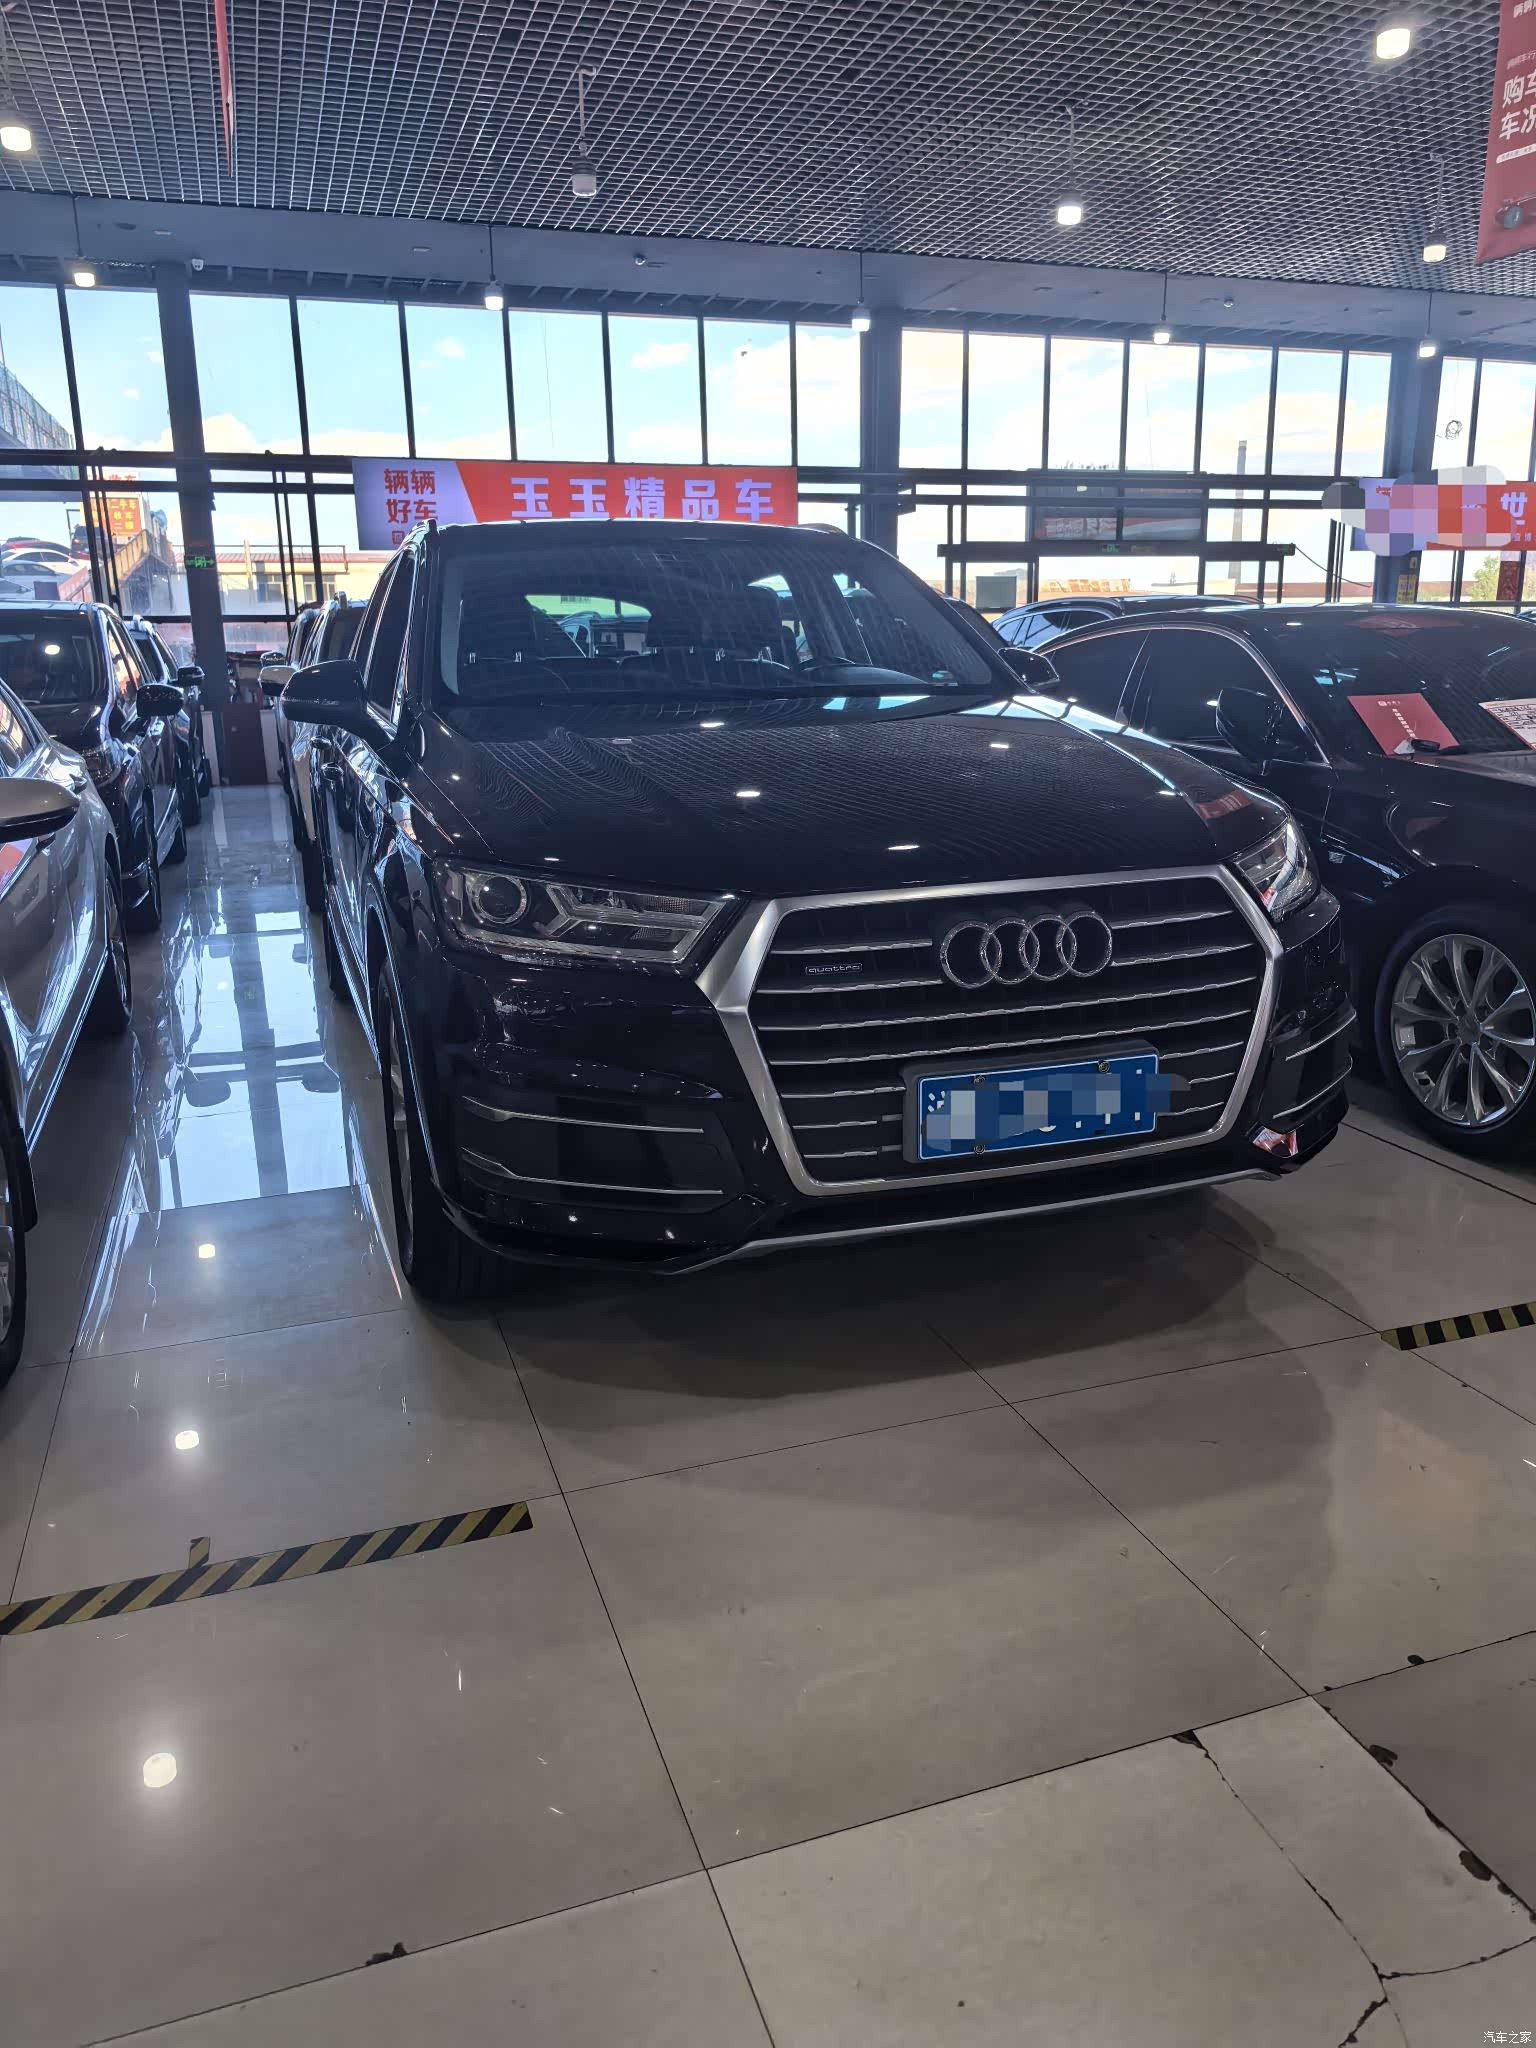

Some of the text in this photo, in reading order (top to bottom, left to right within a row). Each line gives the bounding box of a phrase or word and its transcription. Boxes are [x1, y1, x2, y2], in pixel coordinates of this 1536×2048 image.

[384, 468, 436, 495] 辆辆
[386, 499, 438, 524] 好车
[511, 476, 773, 522] 玉玉精品车
[807, 964, 861, 975] quattro
